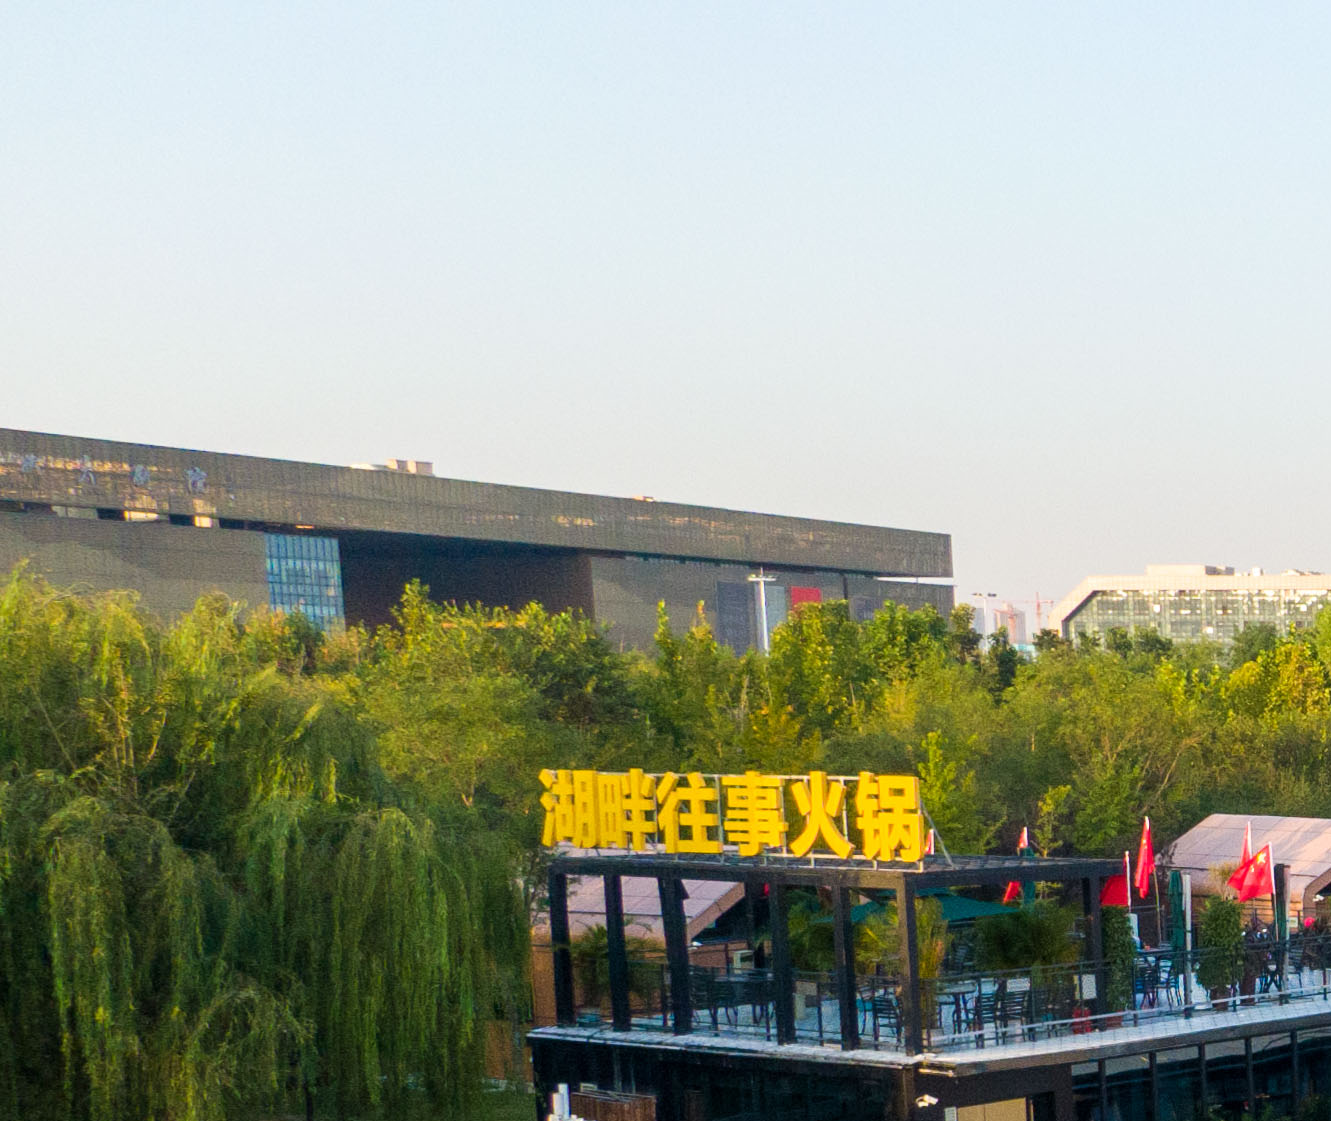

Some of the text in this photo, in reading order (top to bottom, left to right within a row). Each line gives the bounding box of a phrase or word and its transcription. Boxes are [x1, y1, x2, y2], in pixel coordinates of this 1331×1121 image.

[539, 768, 925, 863] 湖畔往事火锅
